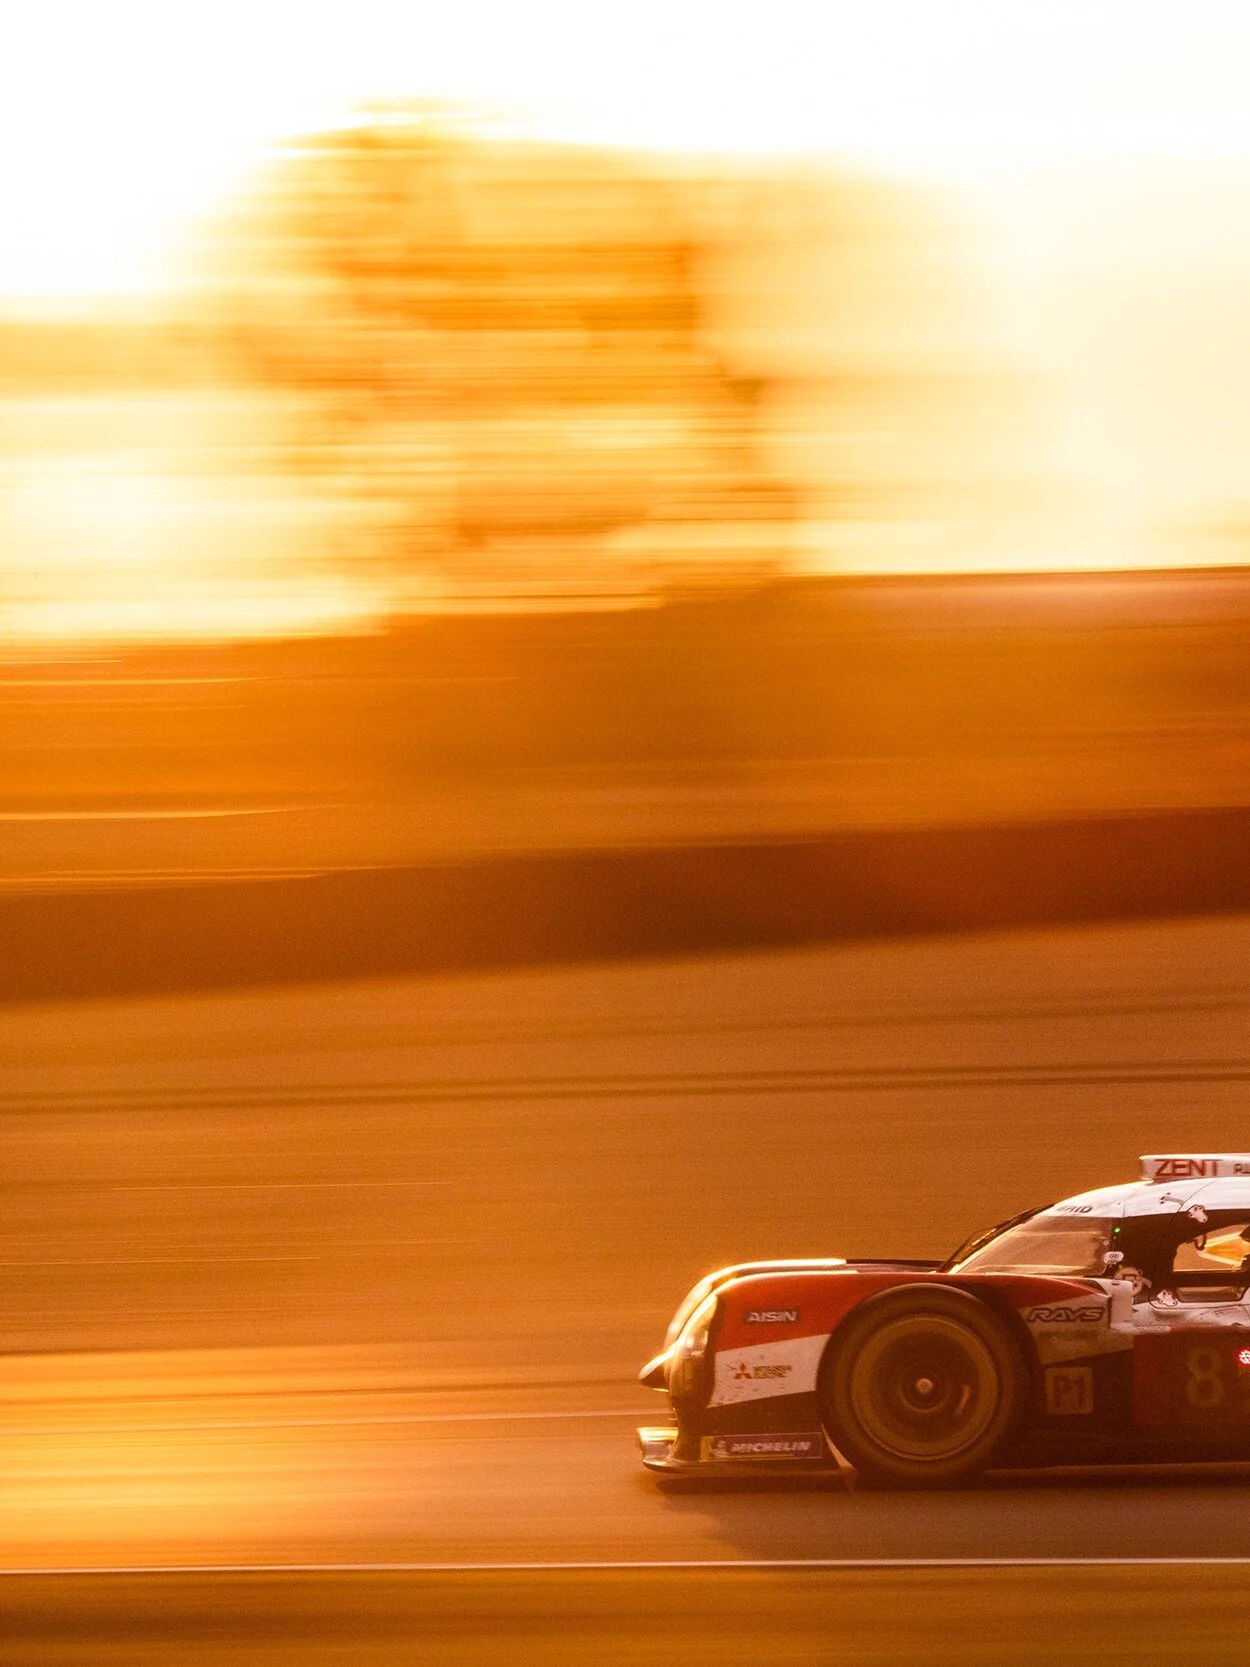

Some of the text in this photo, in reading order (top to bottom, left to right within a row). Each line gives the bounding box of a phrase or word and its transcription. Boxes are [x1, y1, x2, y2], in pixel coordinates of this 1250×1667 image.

[1154, 1159, 1222, 1177] ZENT
[748, 1310, 798, 1323] AISIN
[1028, 1307, 1107, 1322] RAYS
[1186, 1348, 1225, 1408] 8
[1053, 1374, 1086, 1408] P1
[731, 1440, 812, 1453] MICHELIN
